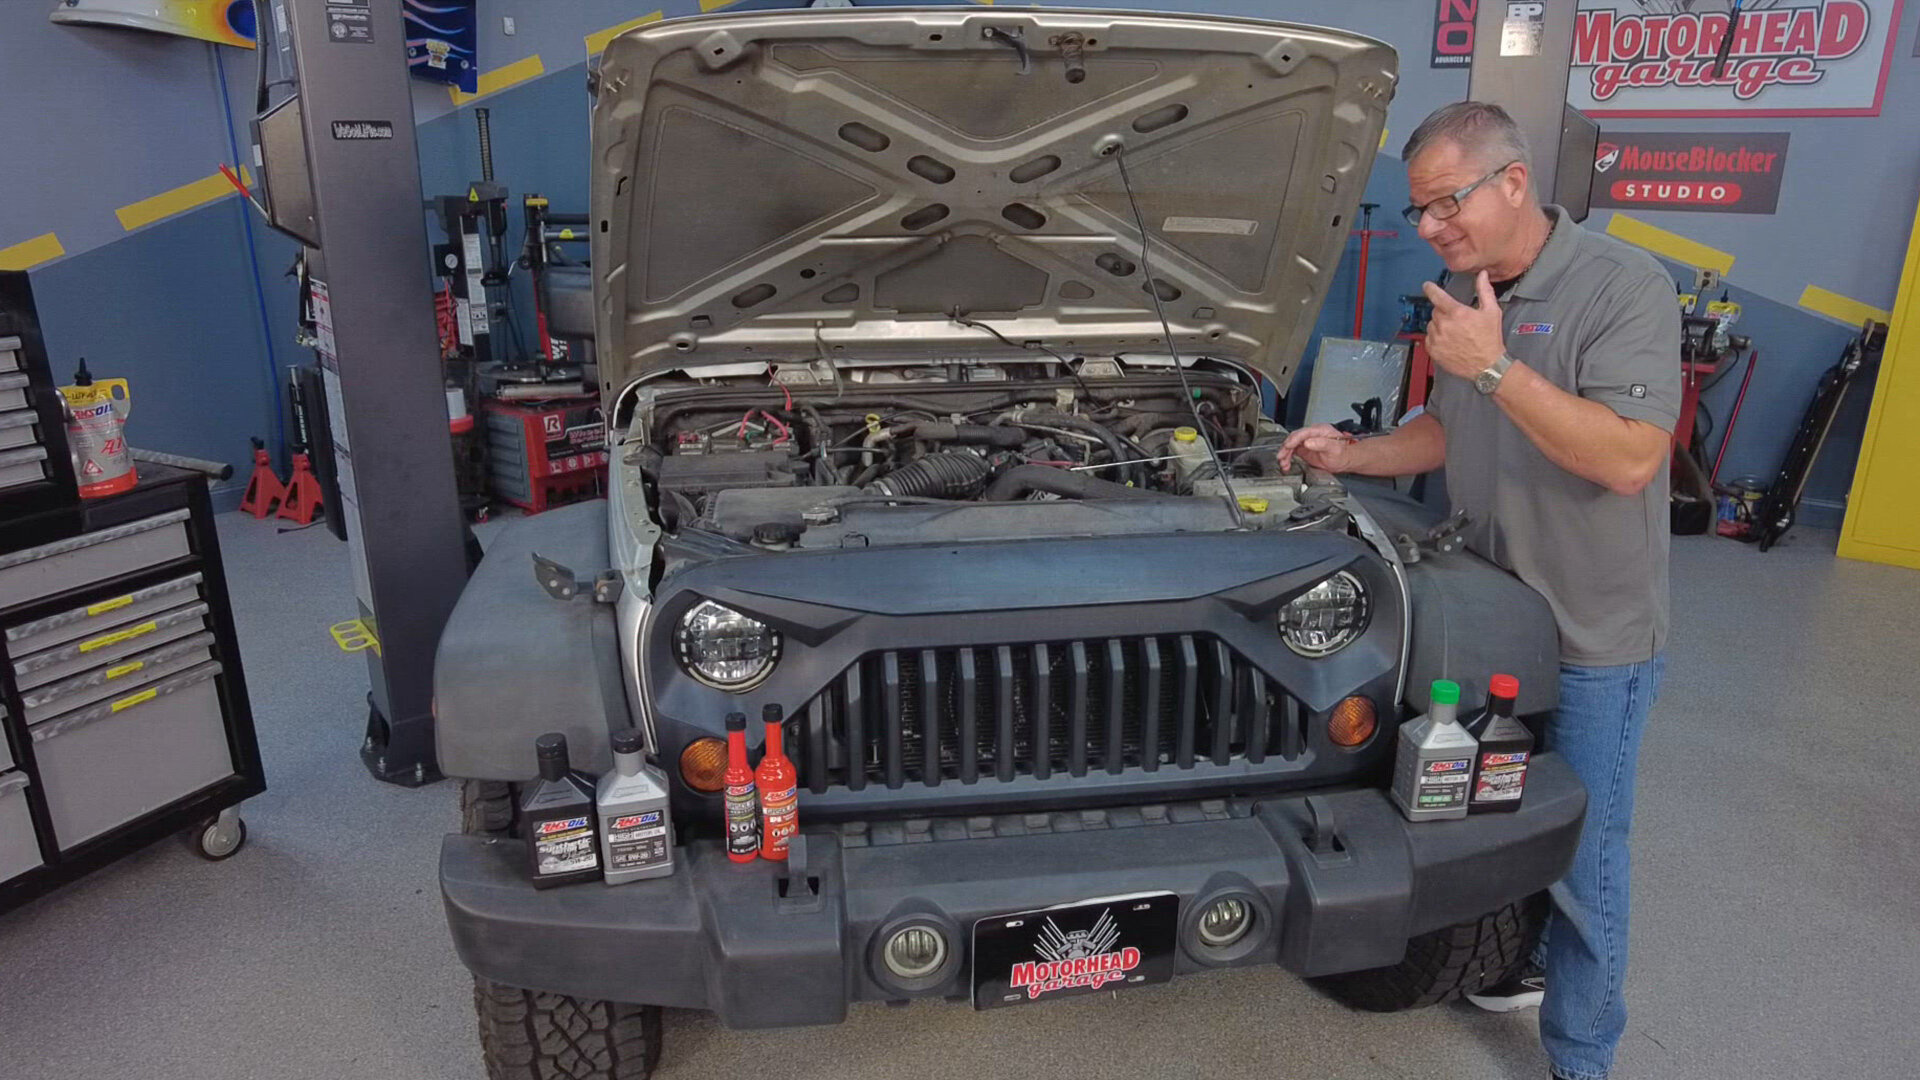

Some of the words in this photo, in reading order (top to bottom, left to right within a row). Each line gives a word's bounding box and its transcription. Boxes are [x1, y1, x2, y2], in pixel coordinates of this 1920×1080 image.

[1573, 1, 1867, 63] MOTORHEAD
[1592, 57, 1824, 100] garage
[1619, 145, 1777, 173] MouseBlocker
[1625, 183, 1726, 200] STUDIO
[536, 816, 588, 834] AMSOIL
[611, 811, 660, 829] AMSOIL
[1010, 947, 1141, 988] MOTORHEAD
[1028, 970, 1126, 999] garage
